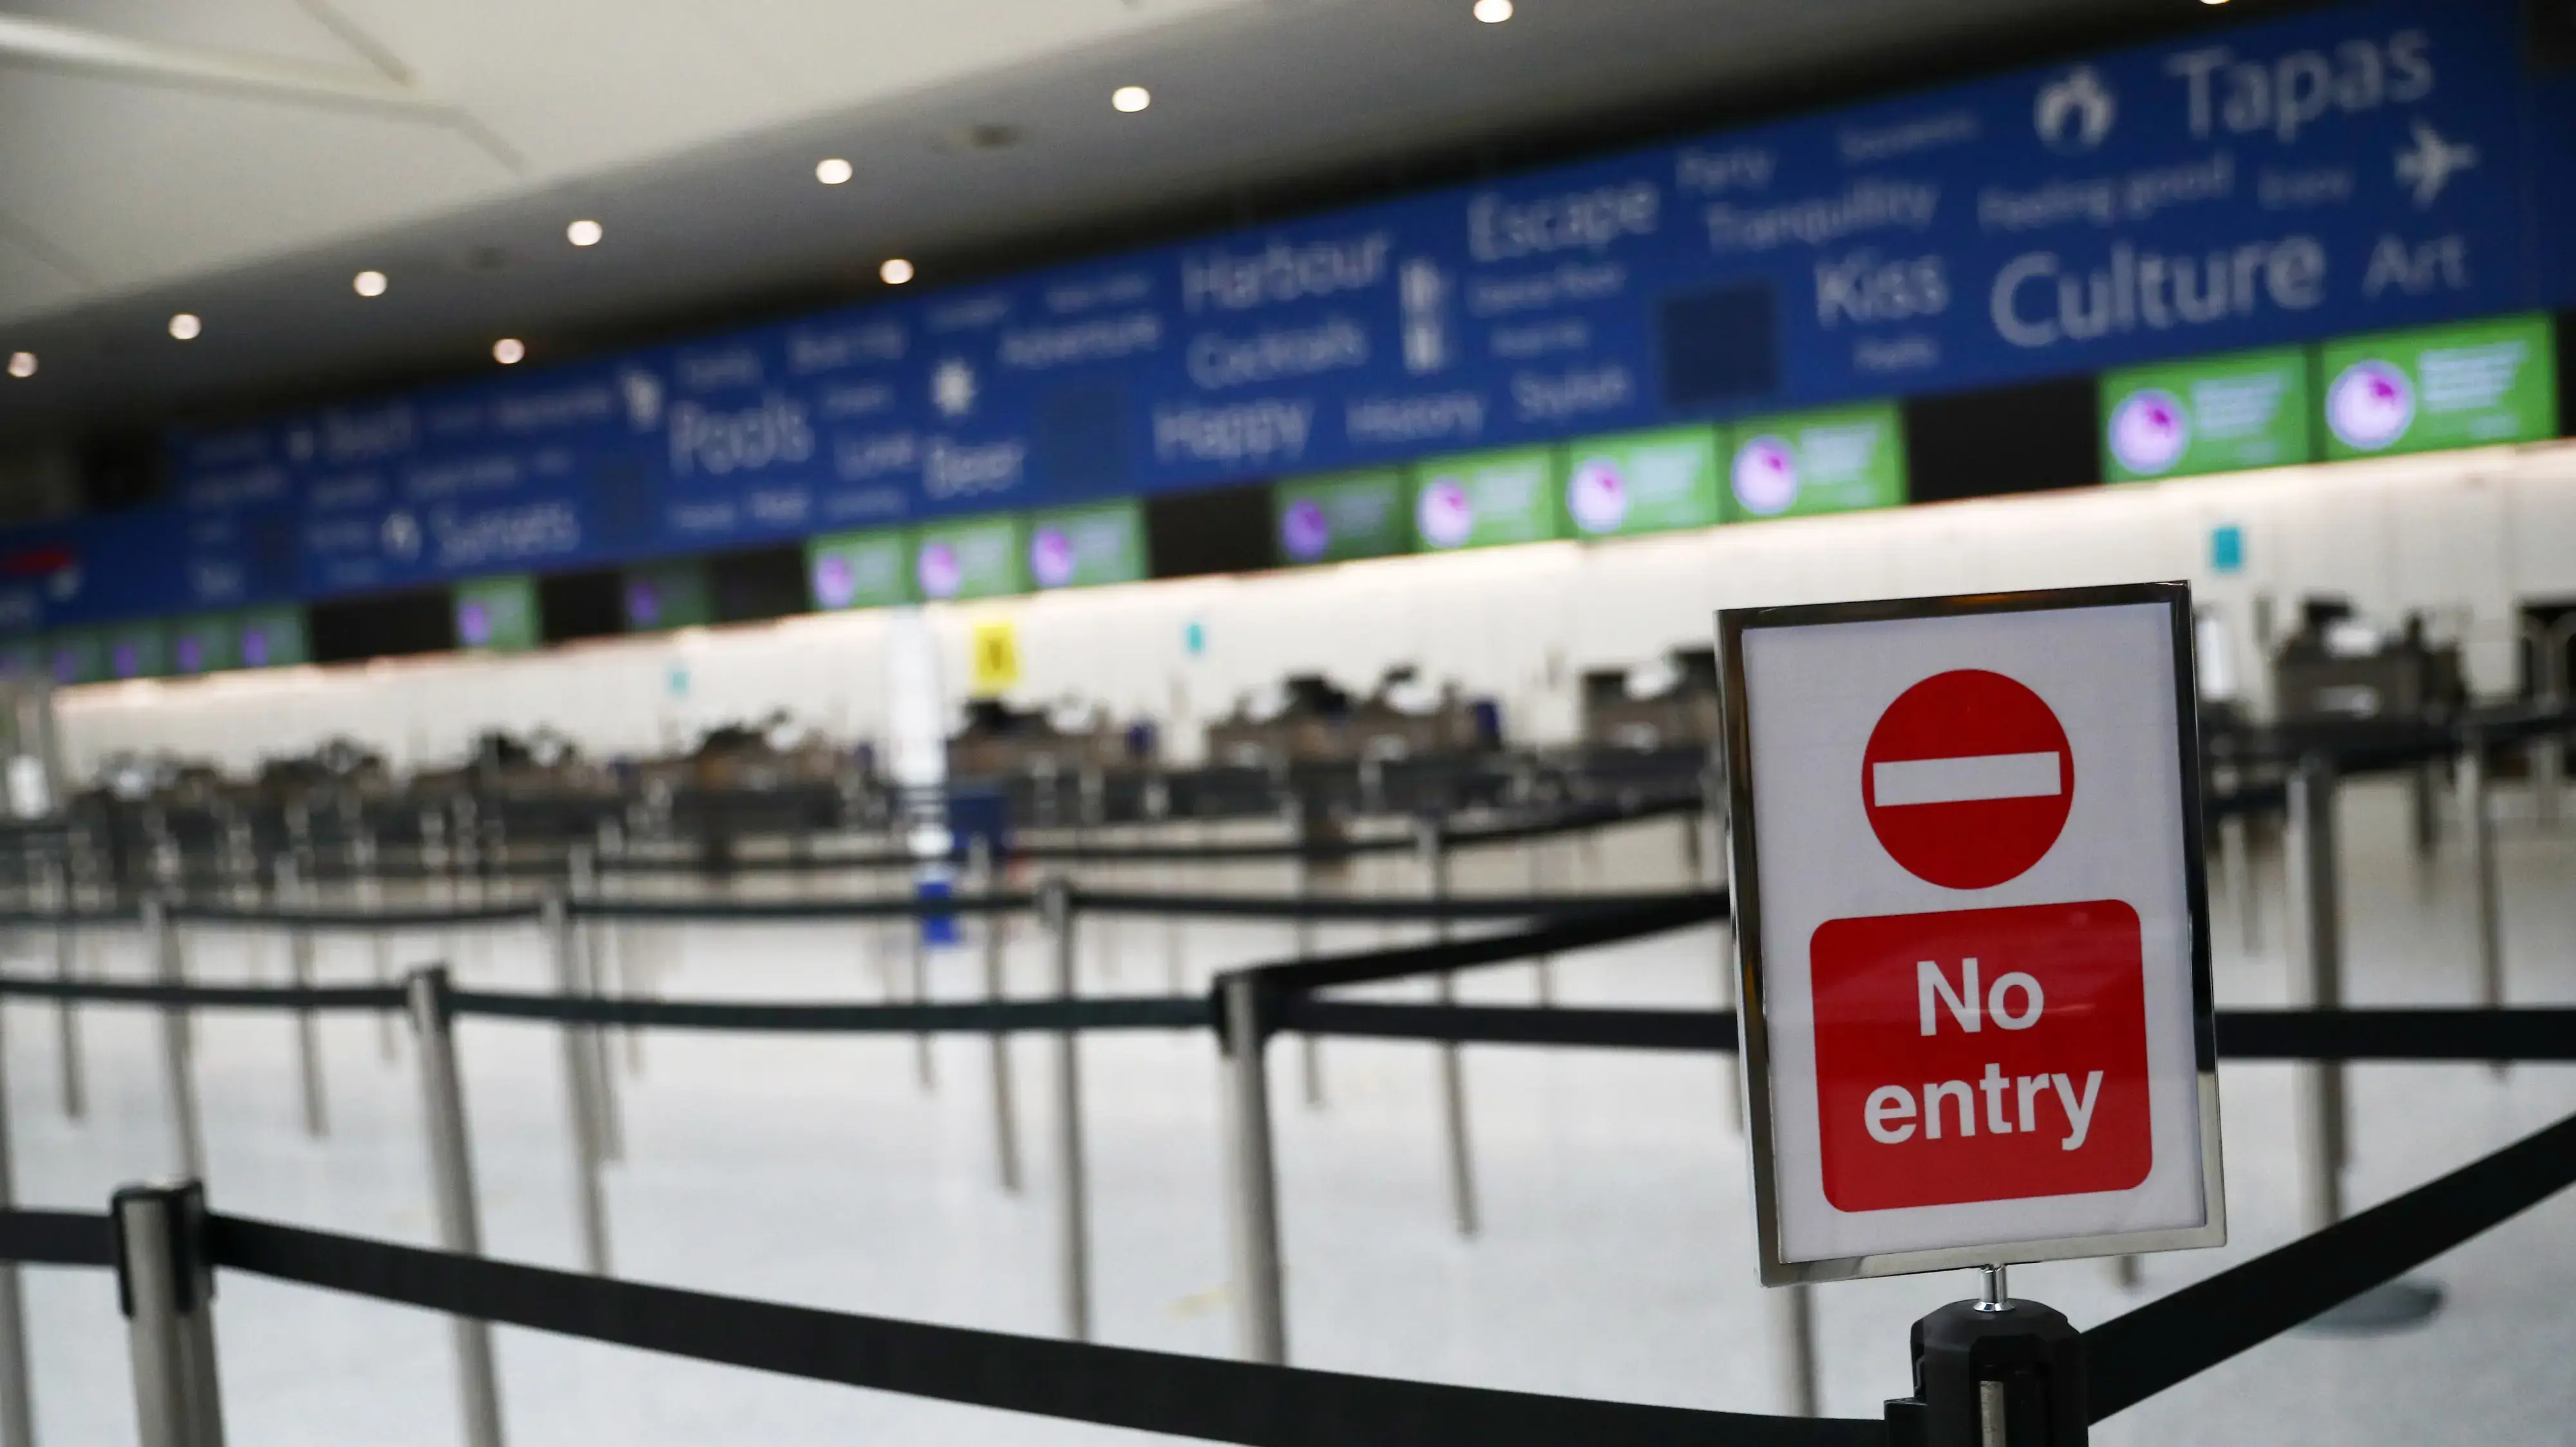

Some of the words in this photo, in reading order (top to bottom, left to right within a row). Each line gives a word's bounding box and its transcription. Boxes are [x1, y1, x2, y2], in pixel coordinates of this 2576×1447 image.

[2164, 29, 2432, 142] Tapas
[1466, 179, 1660, 263] Escape
[1978, 175, 2114, 233] Feeling
[2125, 150, 2235, 221] good
[1182, 229, 1394, 314] Harbour
[1814, 247, 1949, 330] Kiss
[1991, 234, 2327, 348] Culture
[2361, 232, 2468, 298] Art
[1186, 314, 1370, 389] Cocktails
[670, 390, 815, 477] Pools
[1153, 397, 1313, 464] Happy
[1345, 392, 1489, 442] History
[923, 435, 1027, 498] Beer
[1917, 958, 2044, 1036] No
[1864, 1062, 2103, 1151] entry
